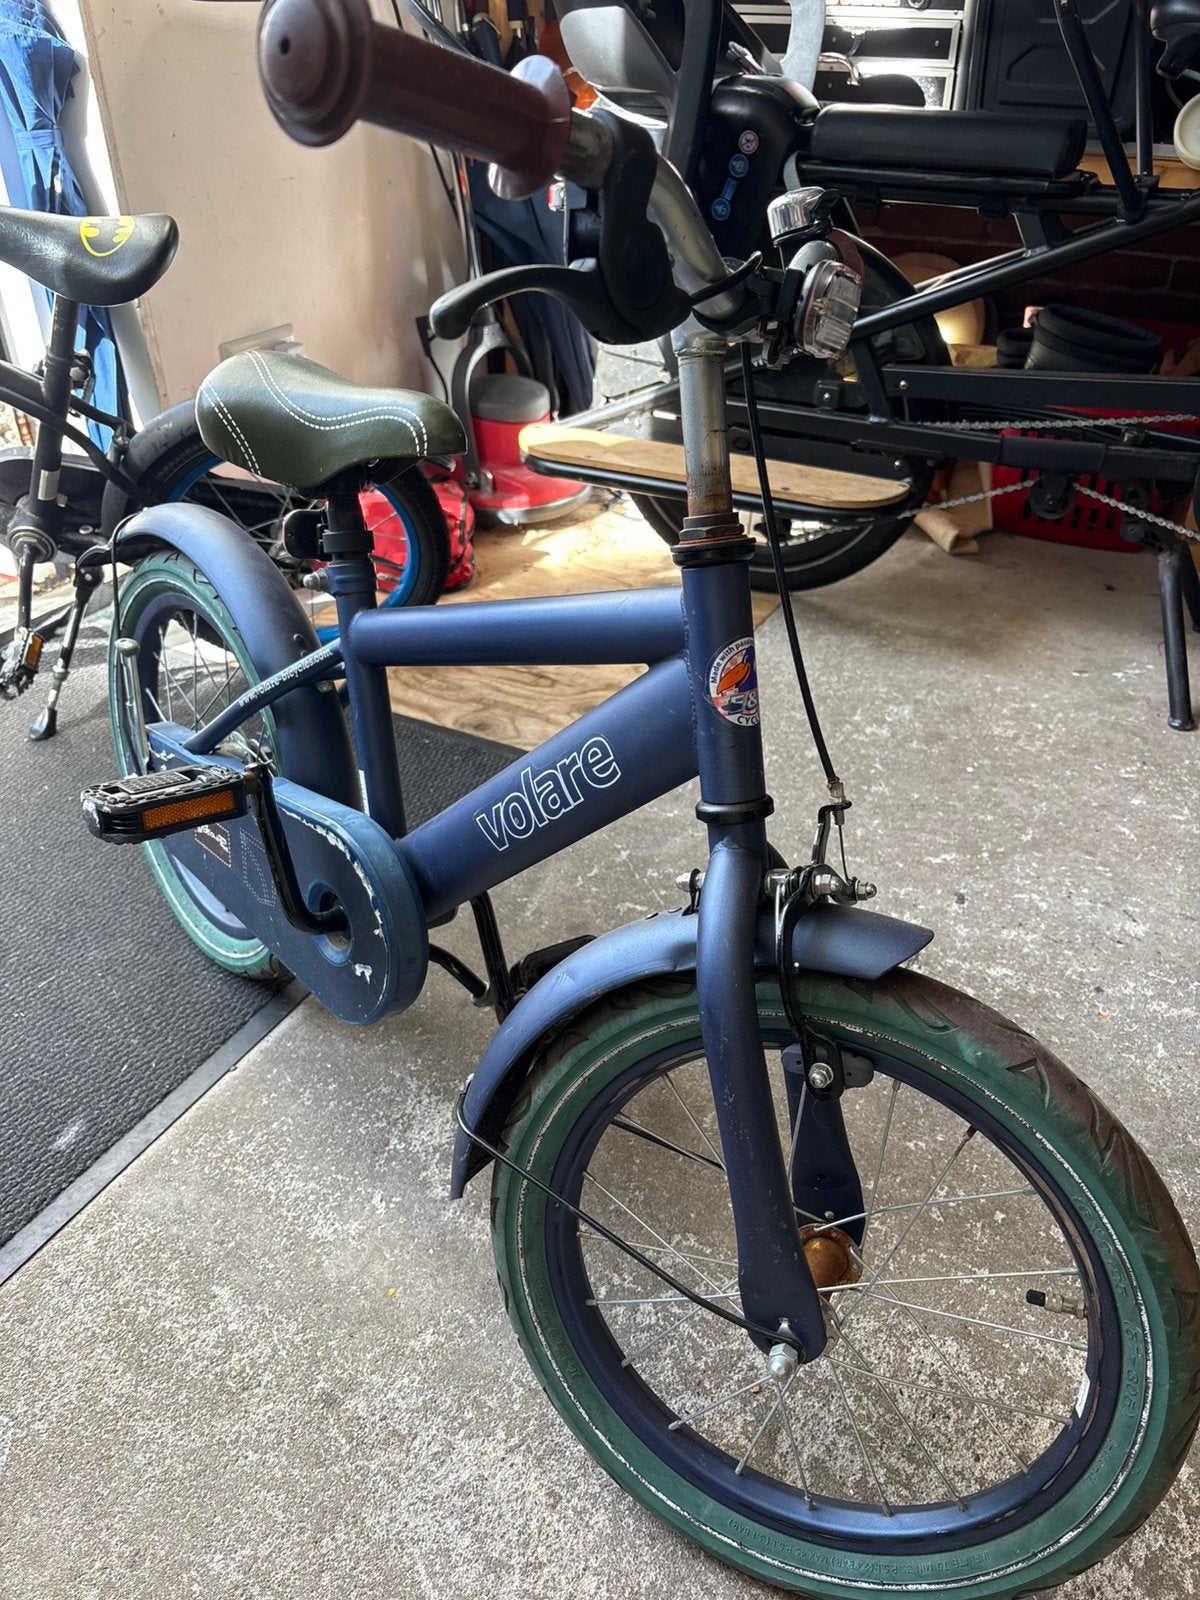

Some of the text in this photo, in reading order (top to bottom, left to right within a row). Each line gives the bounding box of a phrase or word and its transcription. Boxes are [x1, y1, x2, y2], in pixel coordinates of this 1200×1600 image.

[711, 662, 722, 684] Made
[720, 646, 735, 662] with
[476, 736, 621, 851] volare
